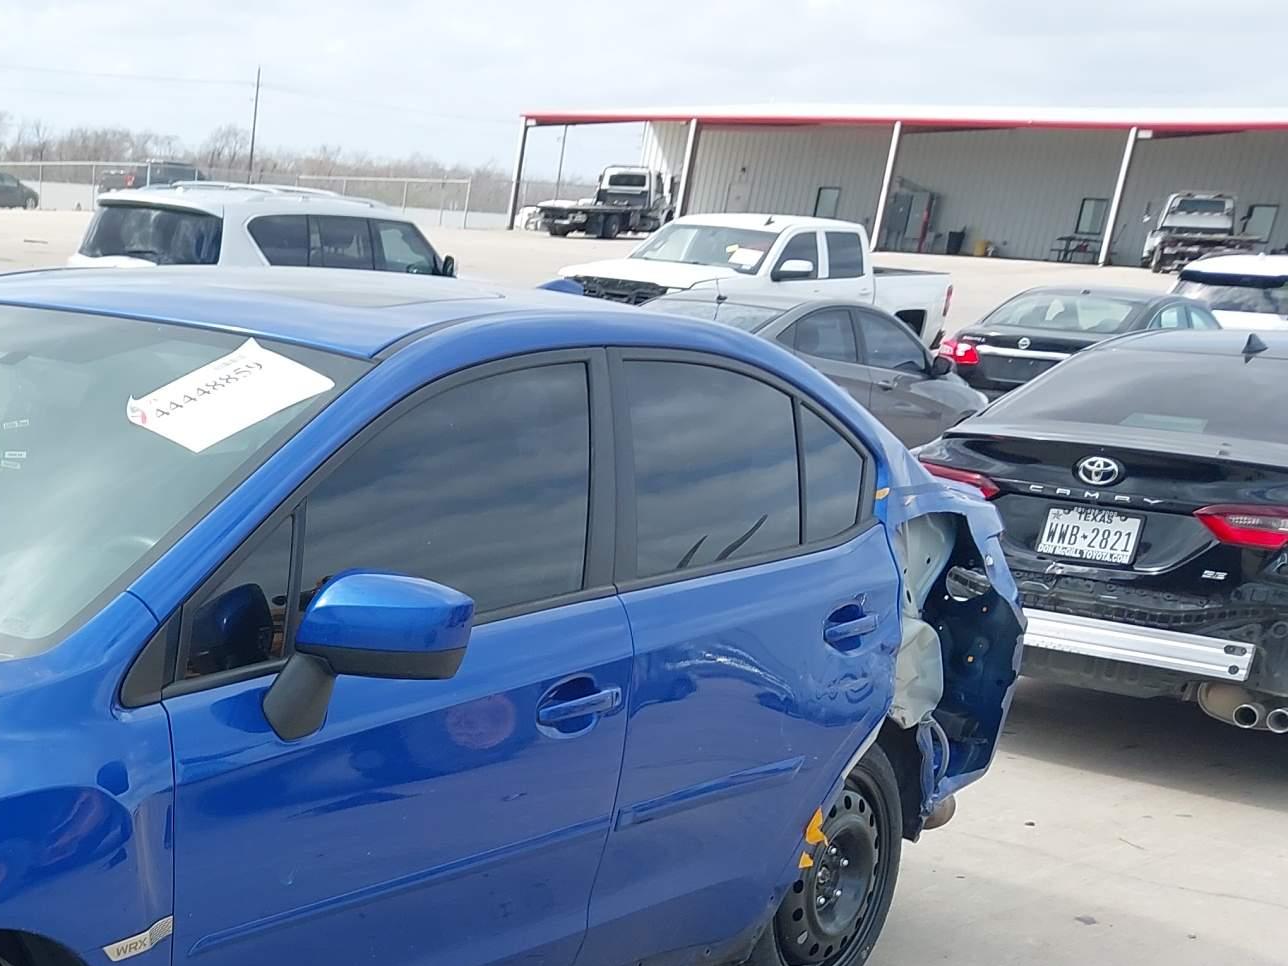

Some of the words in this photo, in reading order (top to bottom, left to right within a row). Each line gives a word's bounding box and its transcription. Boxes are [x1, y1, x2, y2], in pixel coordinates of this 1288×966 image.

[155, 362, 263, 418] 44448859
[1029, 484, 1164, 505] CAMRY
[1078, 511, 1114, 525] TEXAS
[1037, 544, 1054, 554] DON
[1201, 570, 1228, 580] SE
[115, 937, 148, 957] WRX
